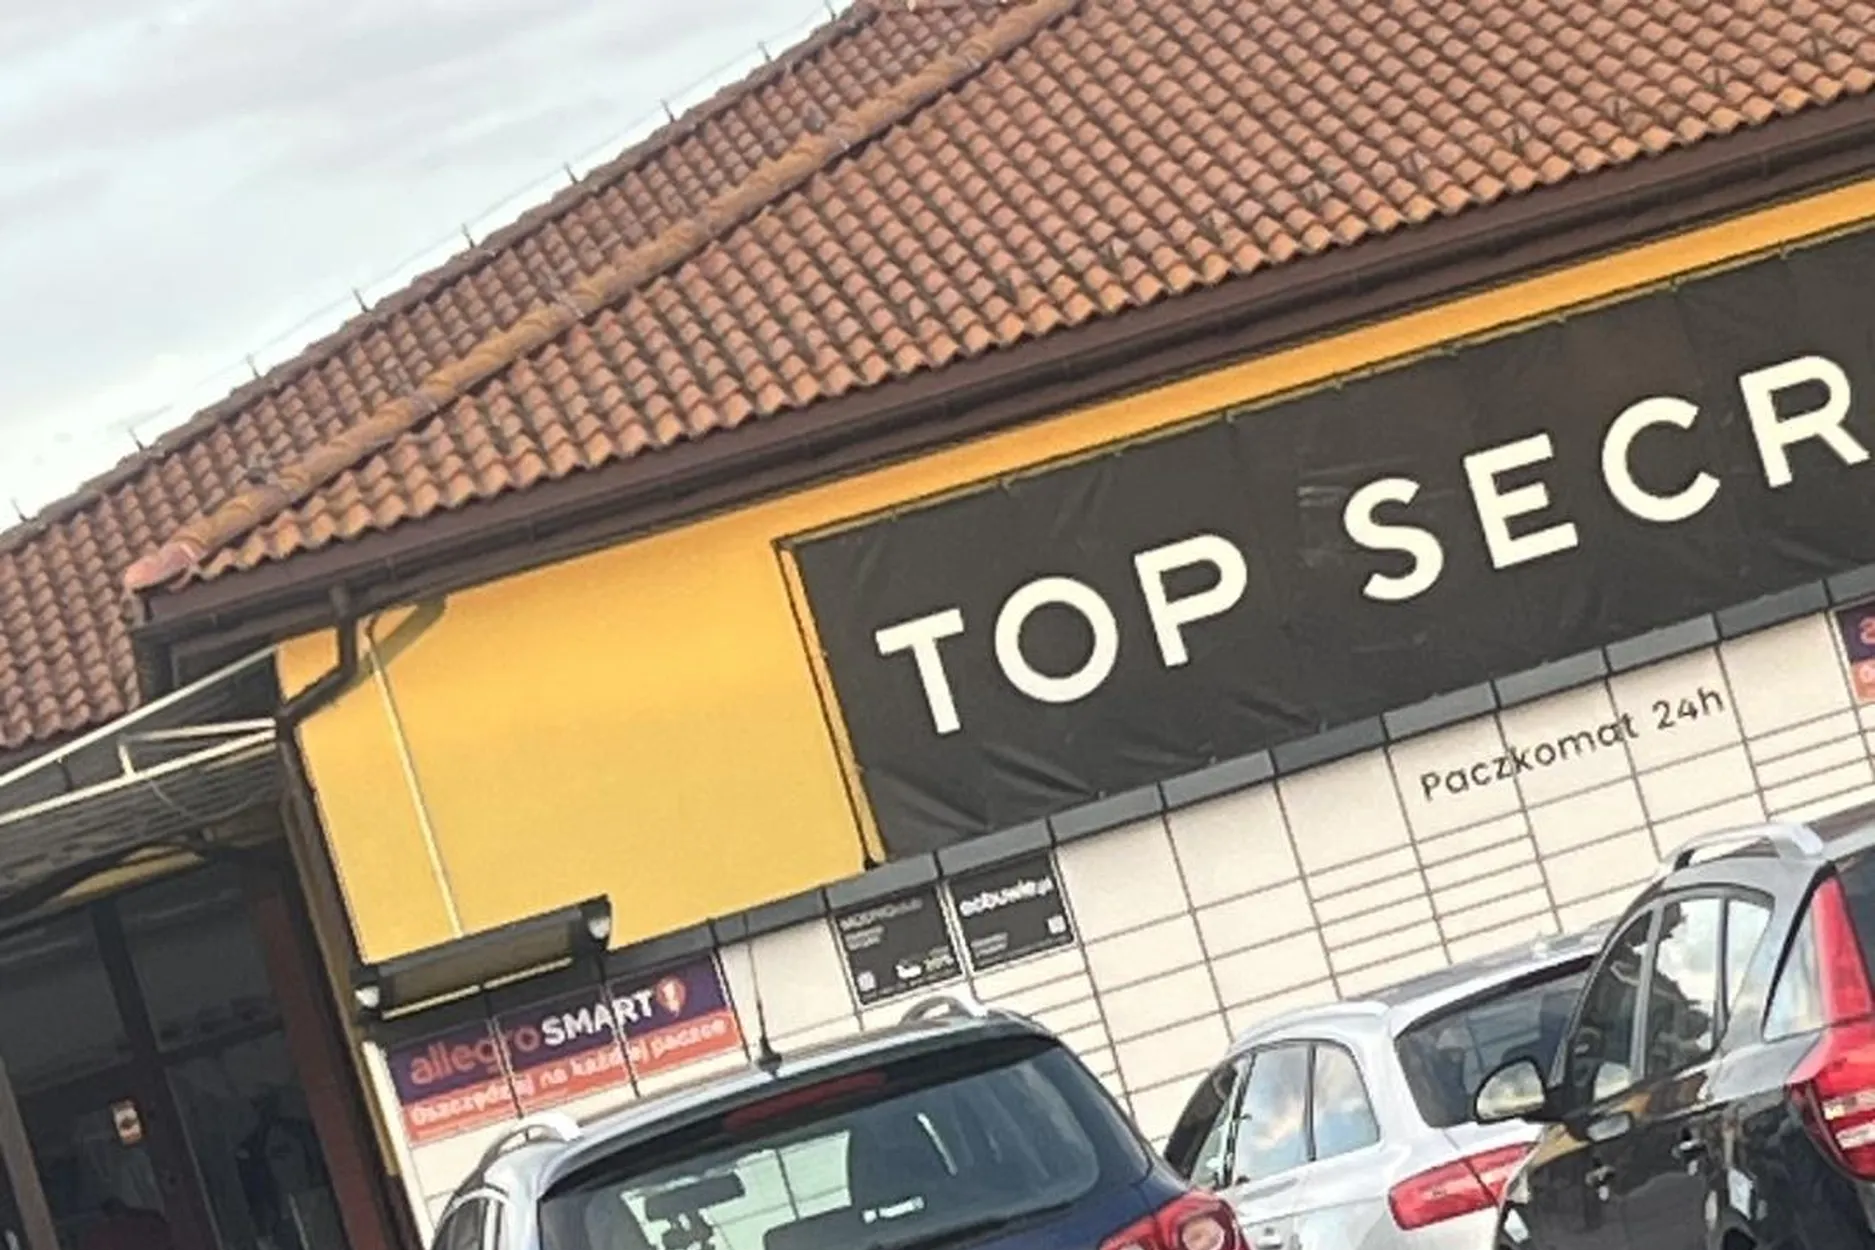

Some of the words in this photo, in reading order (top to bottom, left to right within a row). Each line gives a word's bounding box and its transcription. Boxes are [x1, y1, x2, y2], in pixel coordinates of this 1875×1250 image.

[875, 534, 1247, 734] TOP
[1343, 356, 1870, 600] SECR
[1419, 711, 1640, 801] Paczkomat
[1651, 687, 1725, 729] 24h
